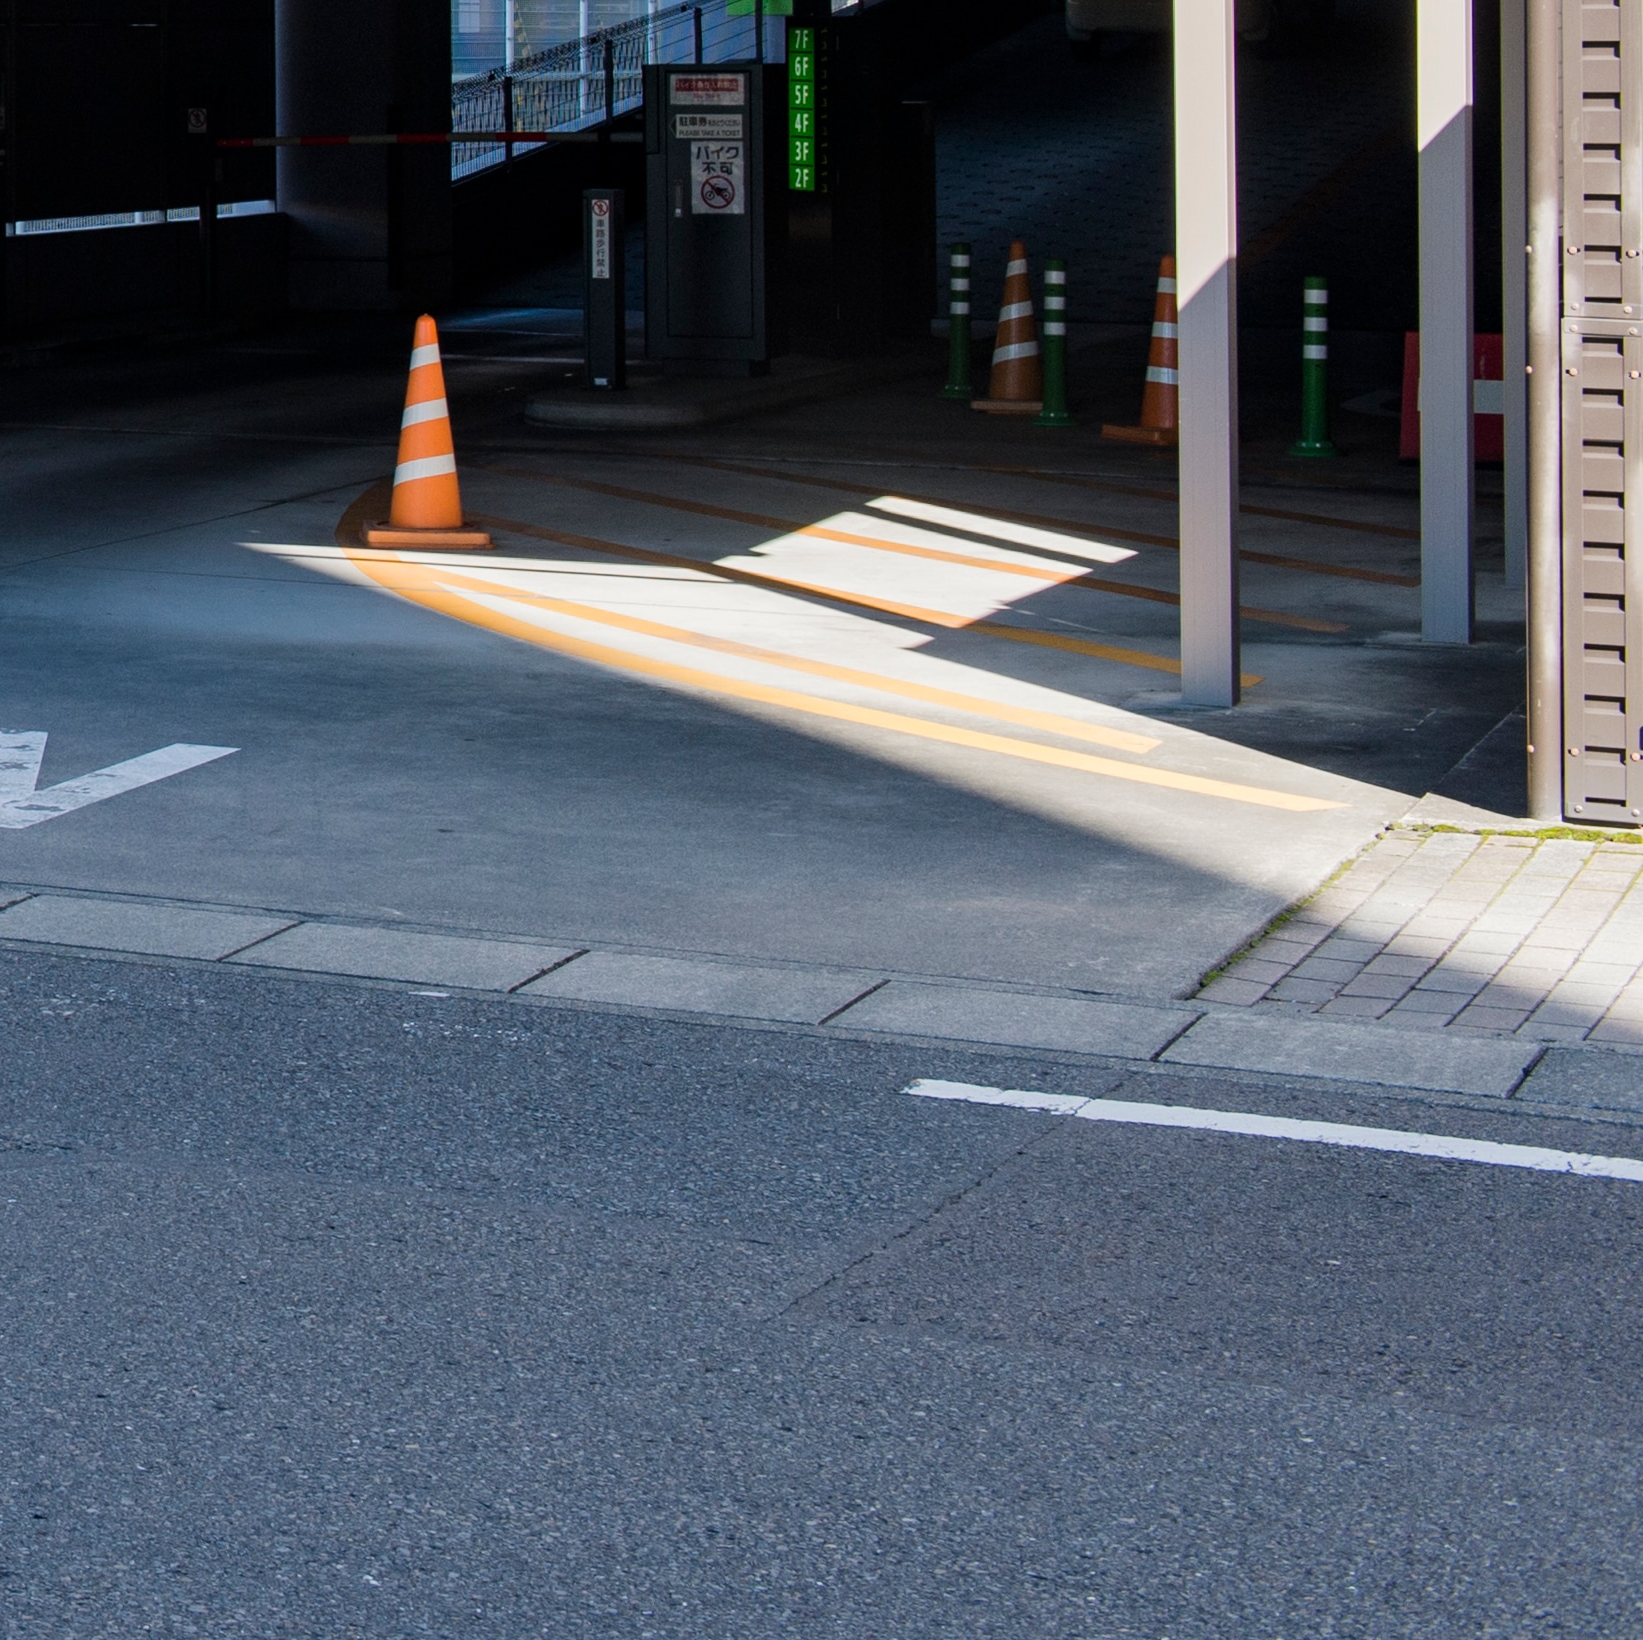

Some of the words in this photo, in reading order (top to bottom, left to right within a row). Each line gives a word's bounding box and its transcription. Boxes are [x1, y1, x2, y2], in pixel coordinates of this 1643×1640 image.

[794, 29, 809, 49] 7F
[794, 56, 809, 76] 6F
[794, 85, 809, 105] 5F
[794, 113, 809, 133] 4F
[696, 146, 739, 160] バイク
[794, 141, 809, 161] 3F
[702, 161, 733, 175] 不可
[794, 168, 809, 188] 2F
